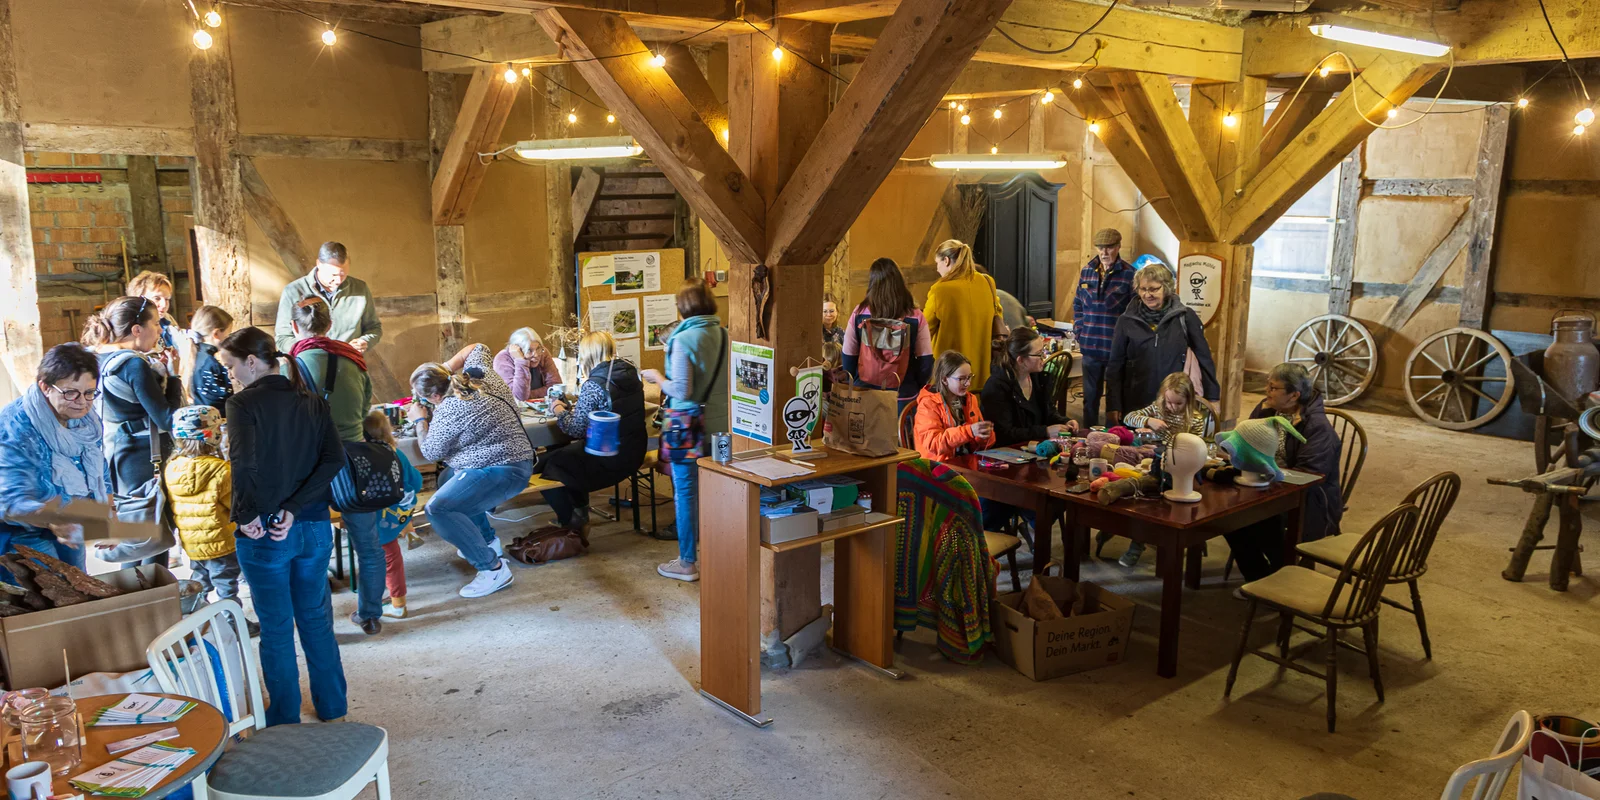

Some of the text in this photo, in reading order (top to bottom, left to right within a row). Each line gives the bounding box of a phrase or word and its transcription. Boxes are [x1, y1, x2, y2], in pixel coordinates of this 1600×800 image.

[1047, 625, 1112, 643] Deine Region.
[1046, 640, 1102, 658] Dein Markt.
